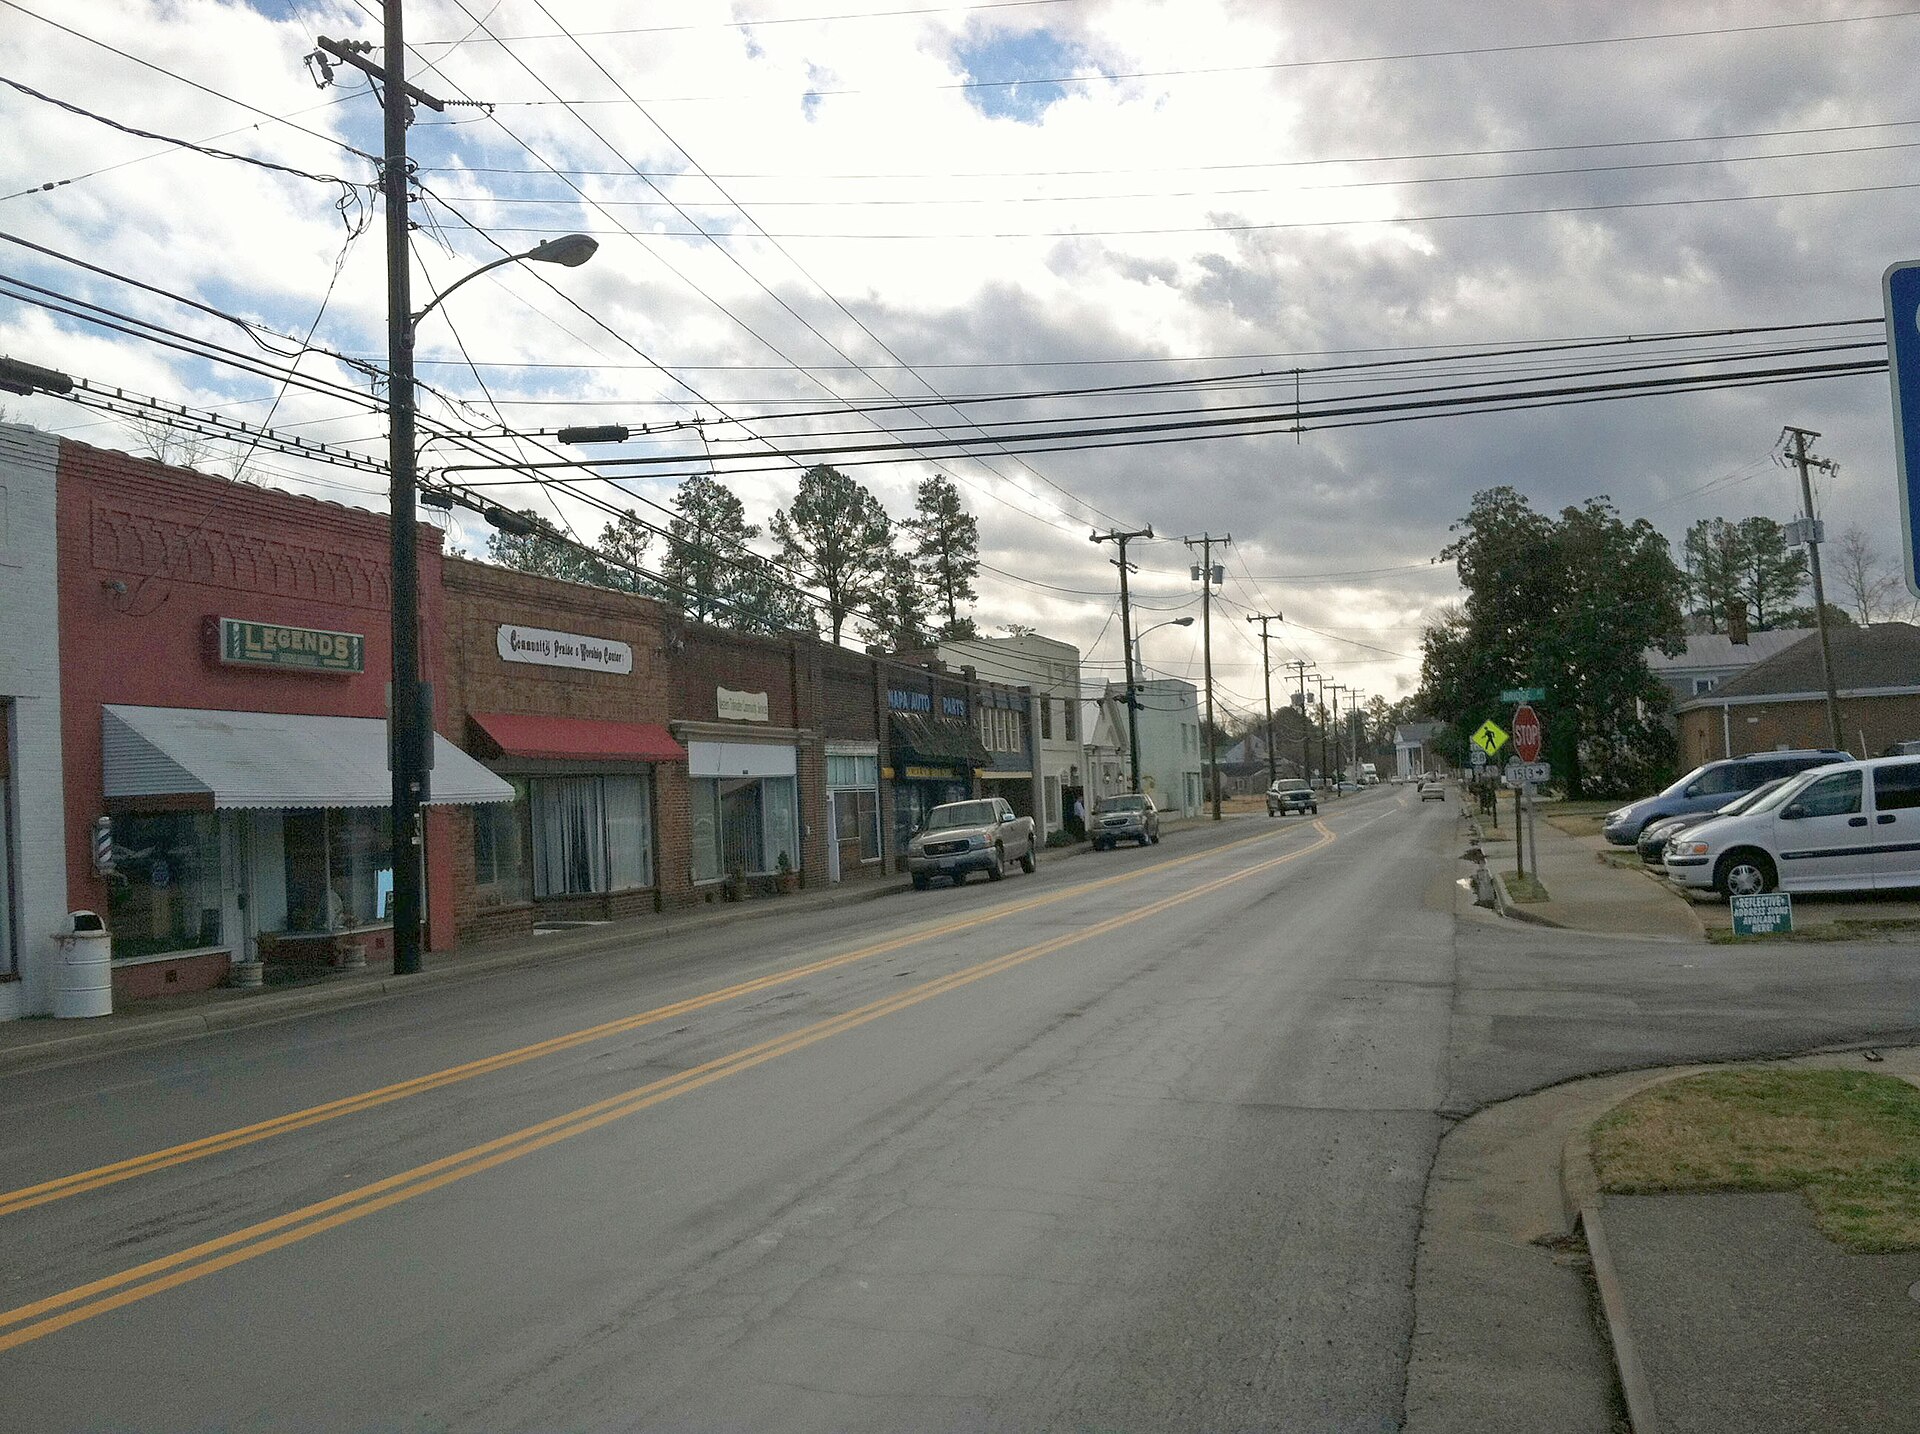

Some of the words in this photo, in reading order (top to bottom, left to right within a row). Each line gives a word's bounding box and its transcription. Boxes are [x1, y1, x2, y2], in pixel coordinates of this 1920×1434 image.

[245, 625, 349, 660] LEGENDS
[511, 630, 550, 656] Community
[554, 640, 574, 658] Praise
[580, 644, 602, 662] Worship
[911, 692, 931, 712] AUTO
[943, 697, 965, 716] PARTS
[1503, 690, 1530, 701] BRIDGE
[1515, 725, 1538, 746] STOP
[1739, 897, 1781, 908] REFLECTIVE
[1743, 915, 1781, 924] AVAILABLE
